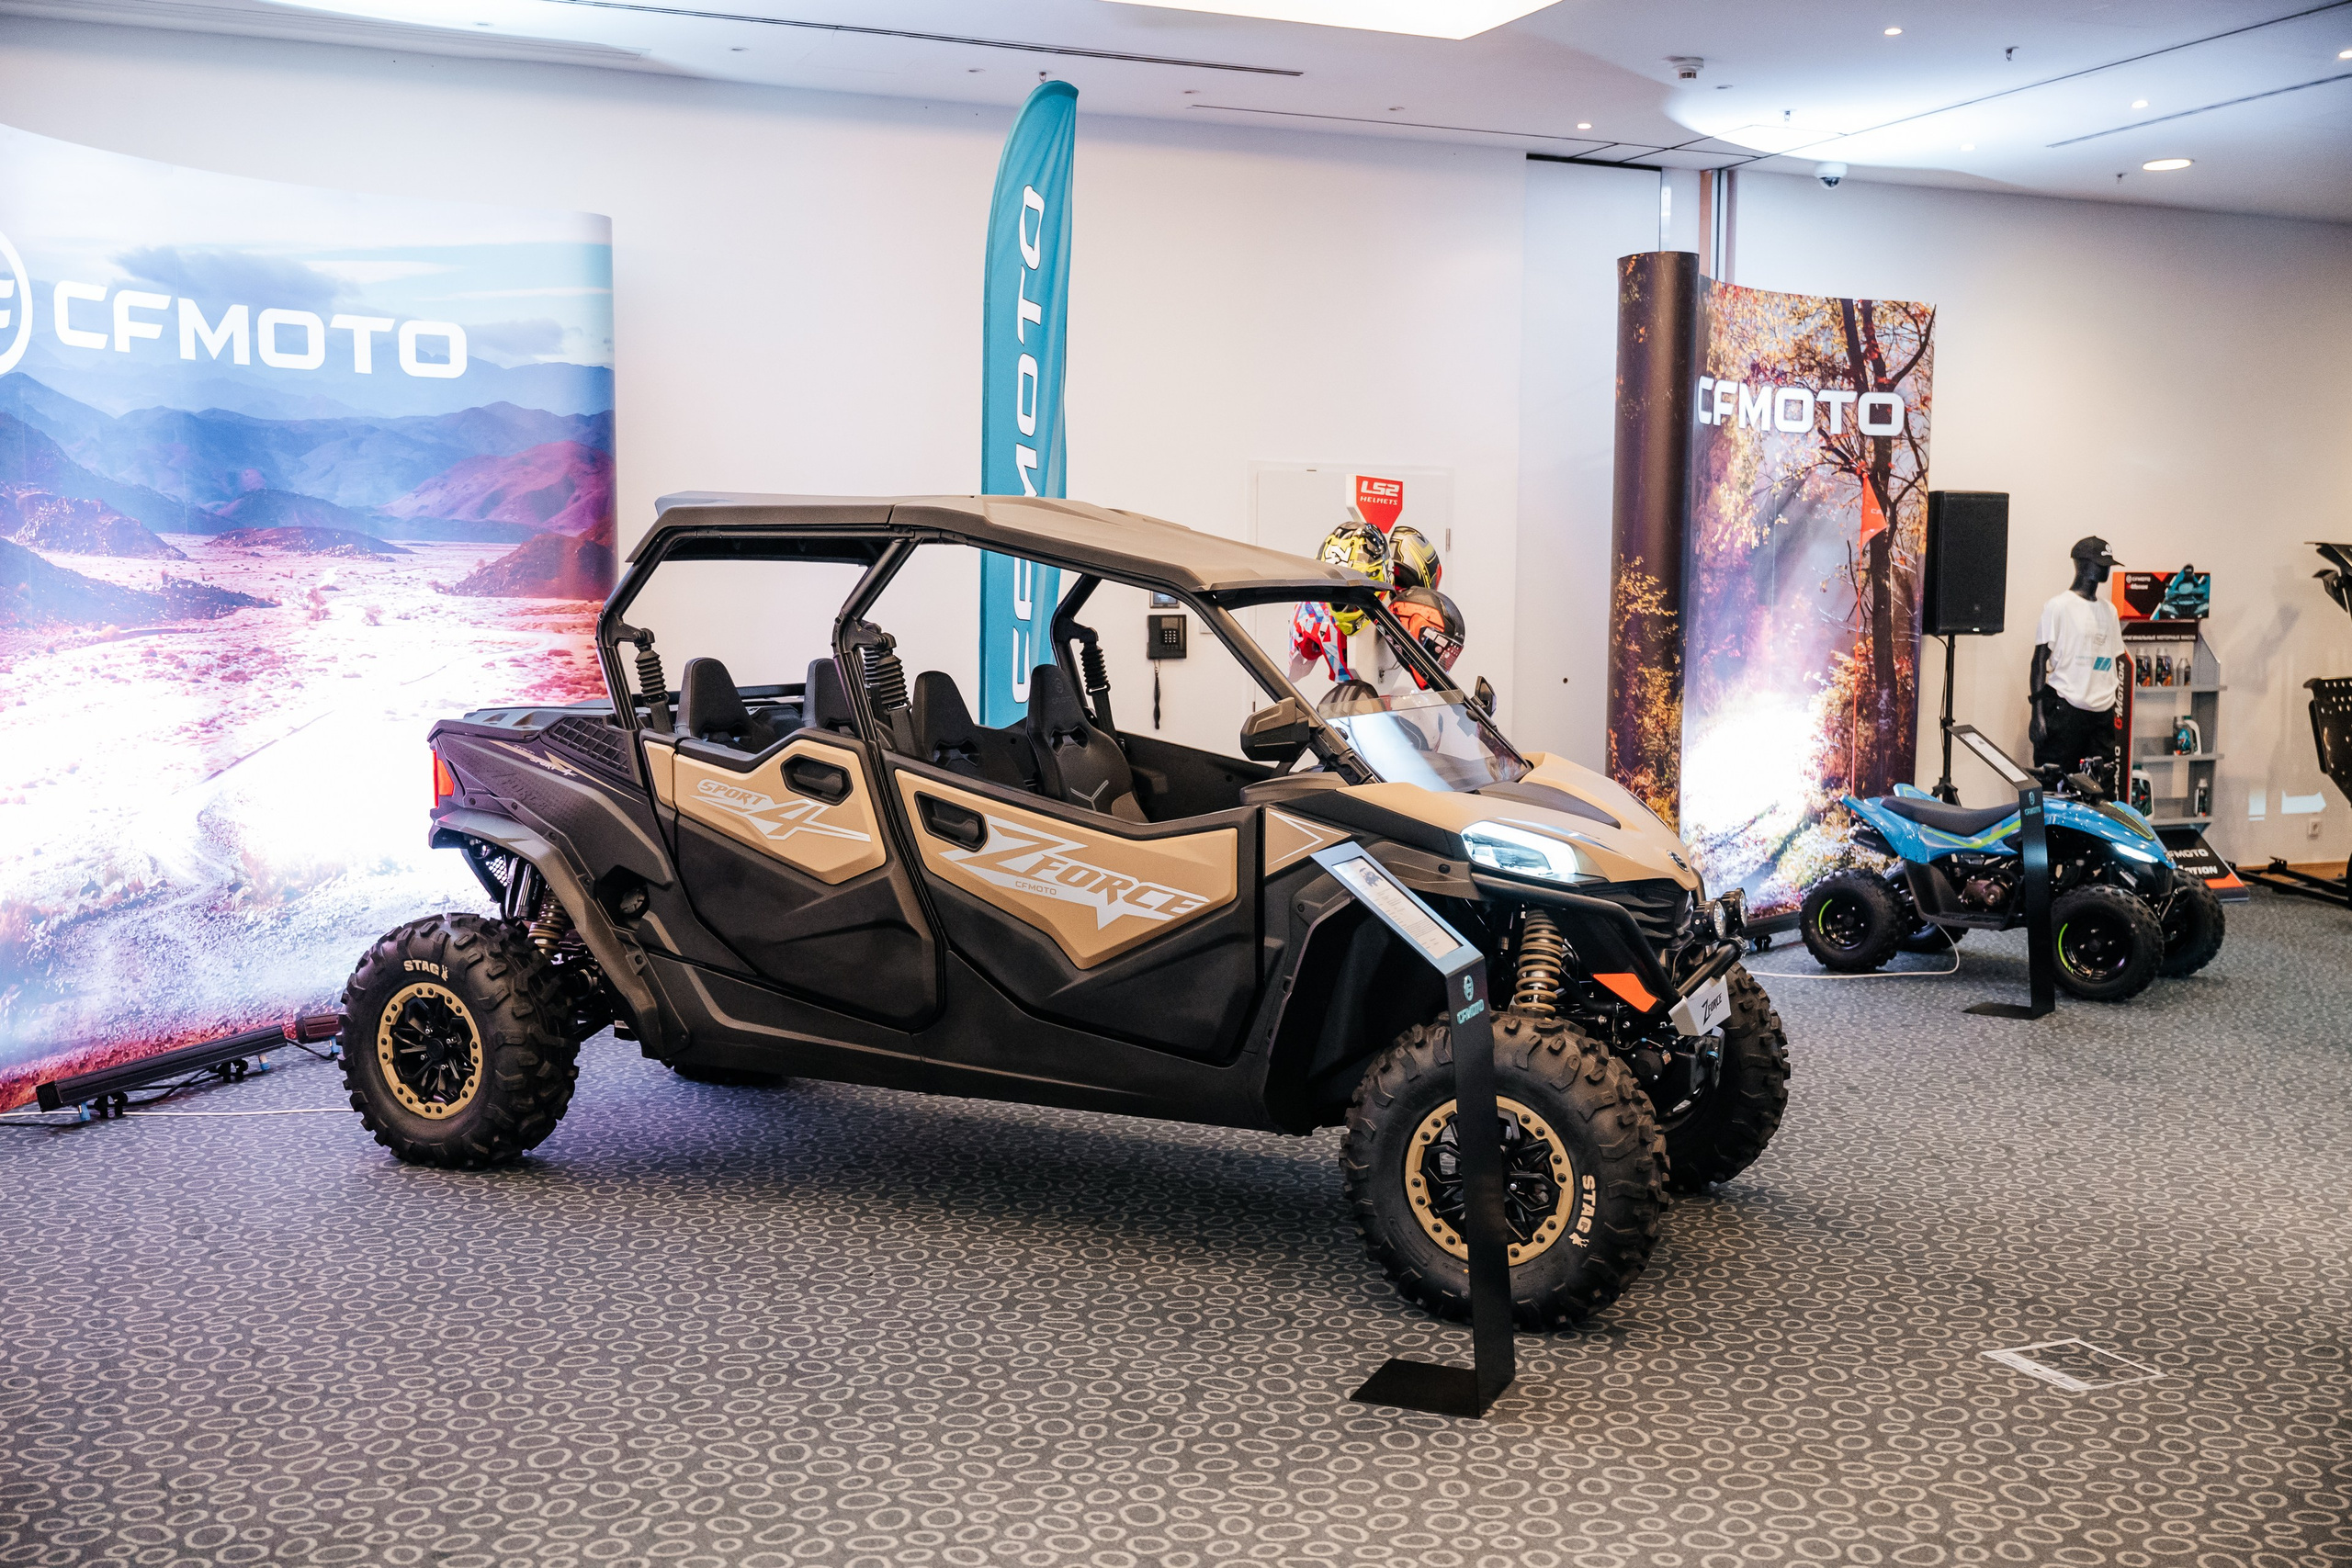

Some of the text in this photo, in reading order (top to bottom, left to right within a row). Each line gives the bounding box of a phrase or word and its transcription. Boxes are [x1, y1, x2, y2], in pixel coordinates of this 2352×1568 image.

[53, 279, 468, 379] CFMOTO
[1697, 375, 1905, 436] CFMOTO
[1360, 479, 1400, 498] LS2
[1360, 495, 1398, 506] HELMETS
[698, 779, 771, 807] SPORT
[1015, 880, 1057, 896] CFMOTO
[403, 959, 440, 976] STAG
[1576, 1175, 1597, 1234] STAG
